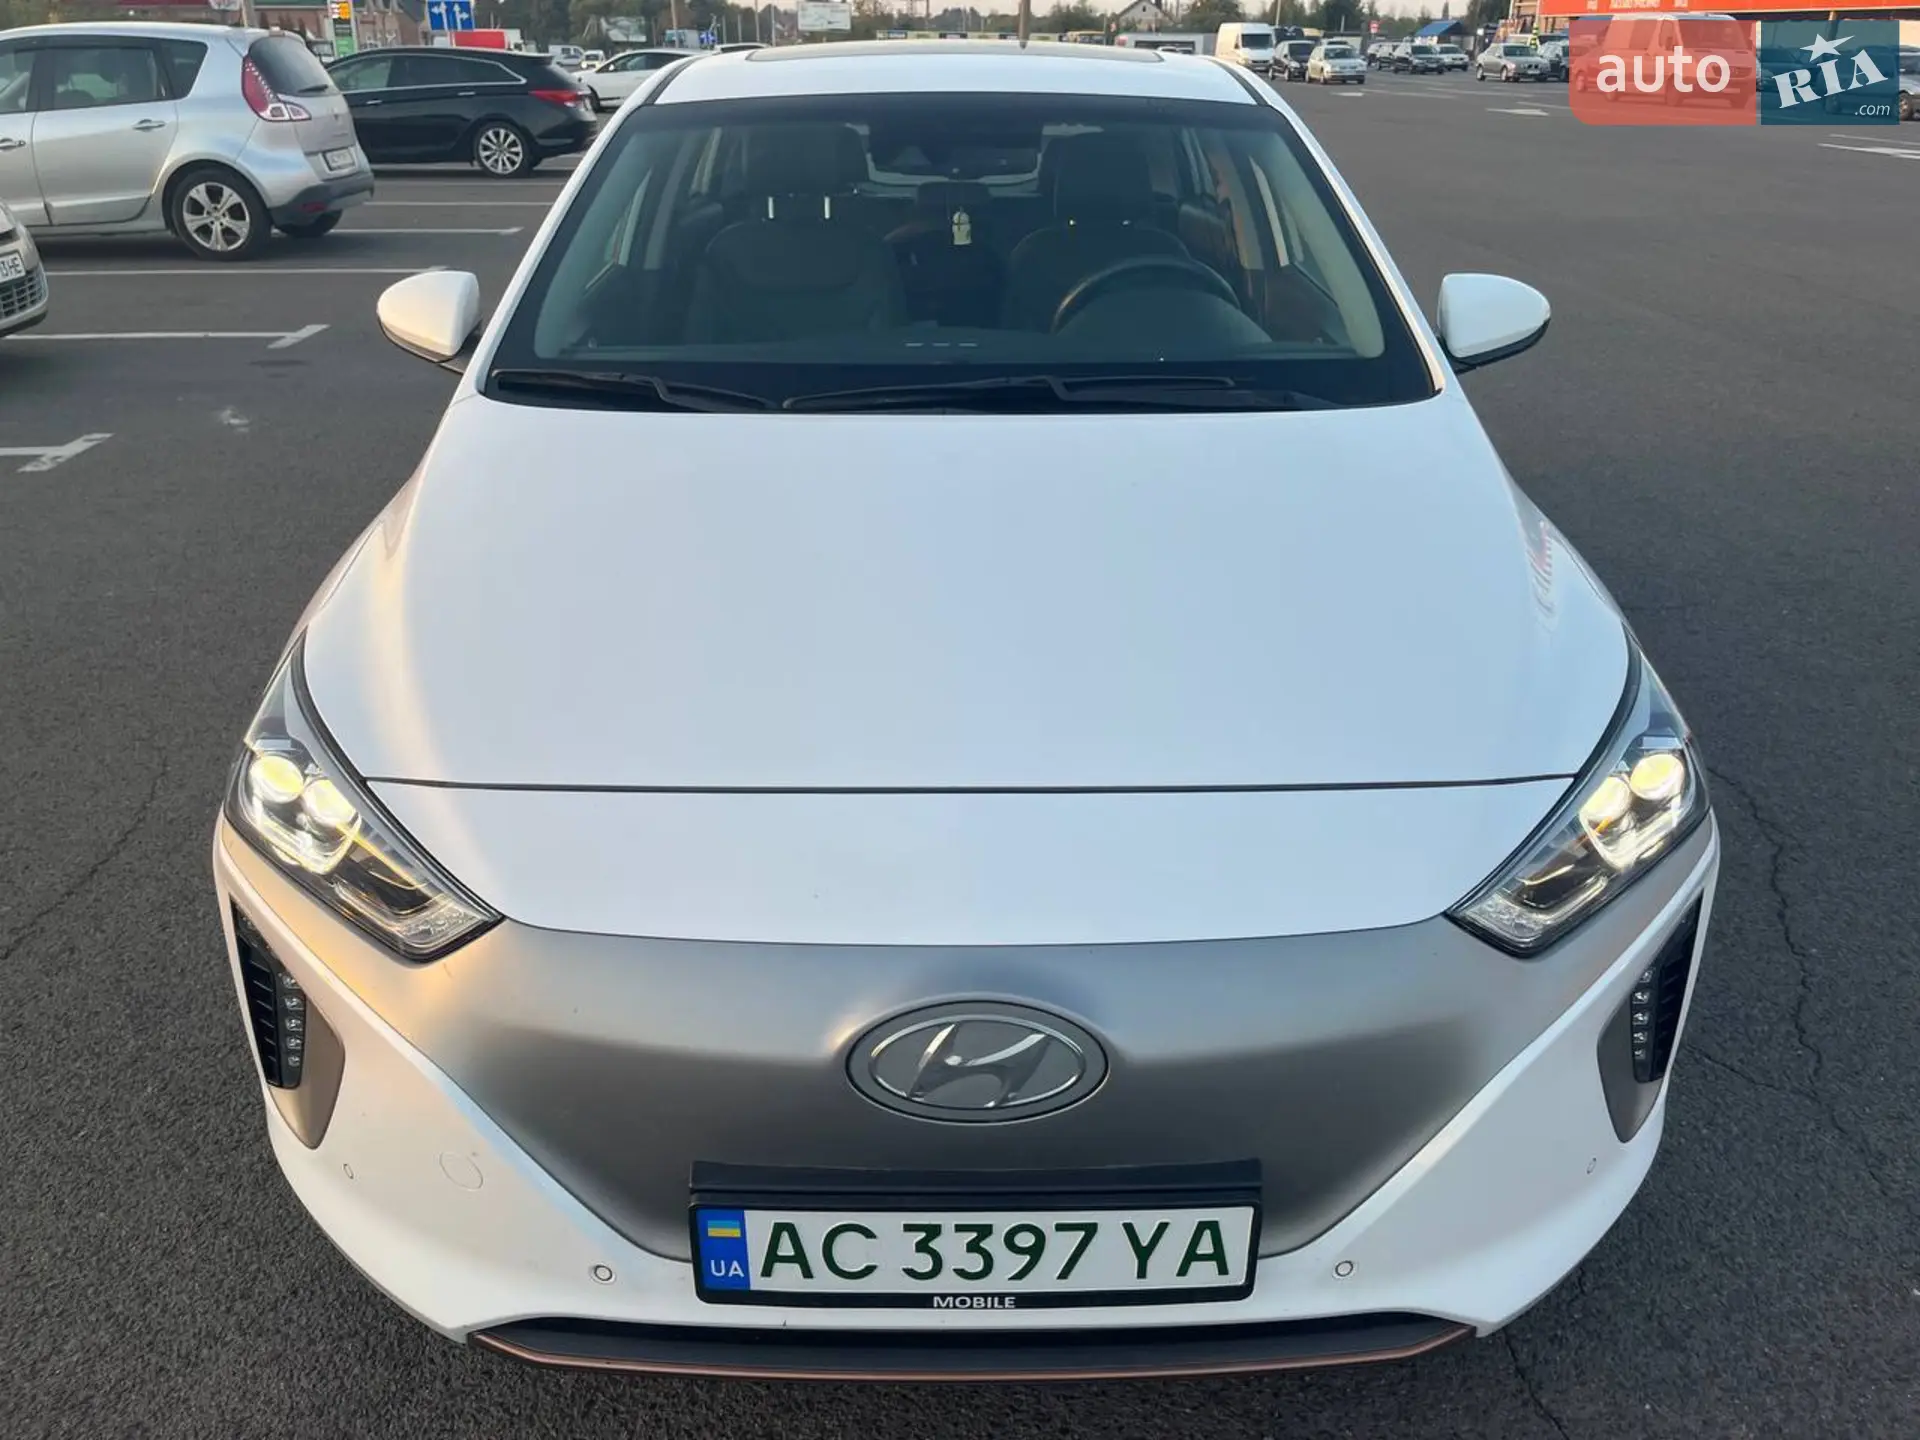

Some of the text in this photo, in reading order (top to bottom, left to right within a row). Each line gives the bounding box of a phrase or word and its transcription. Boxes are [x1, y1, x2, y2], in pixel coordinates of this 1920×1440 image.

[760, 1220, 1229, 1281] AC 3397 YA
[710, 1259, 745, 1278] UA
[932, 1296, 1016, 1309] MOBILE
